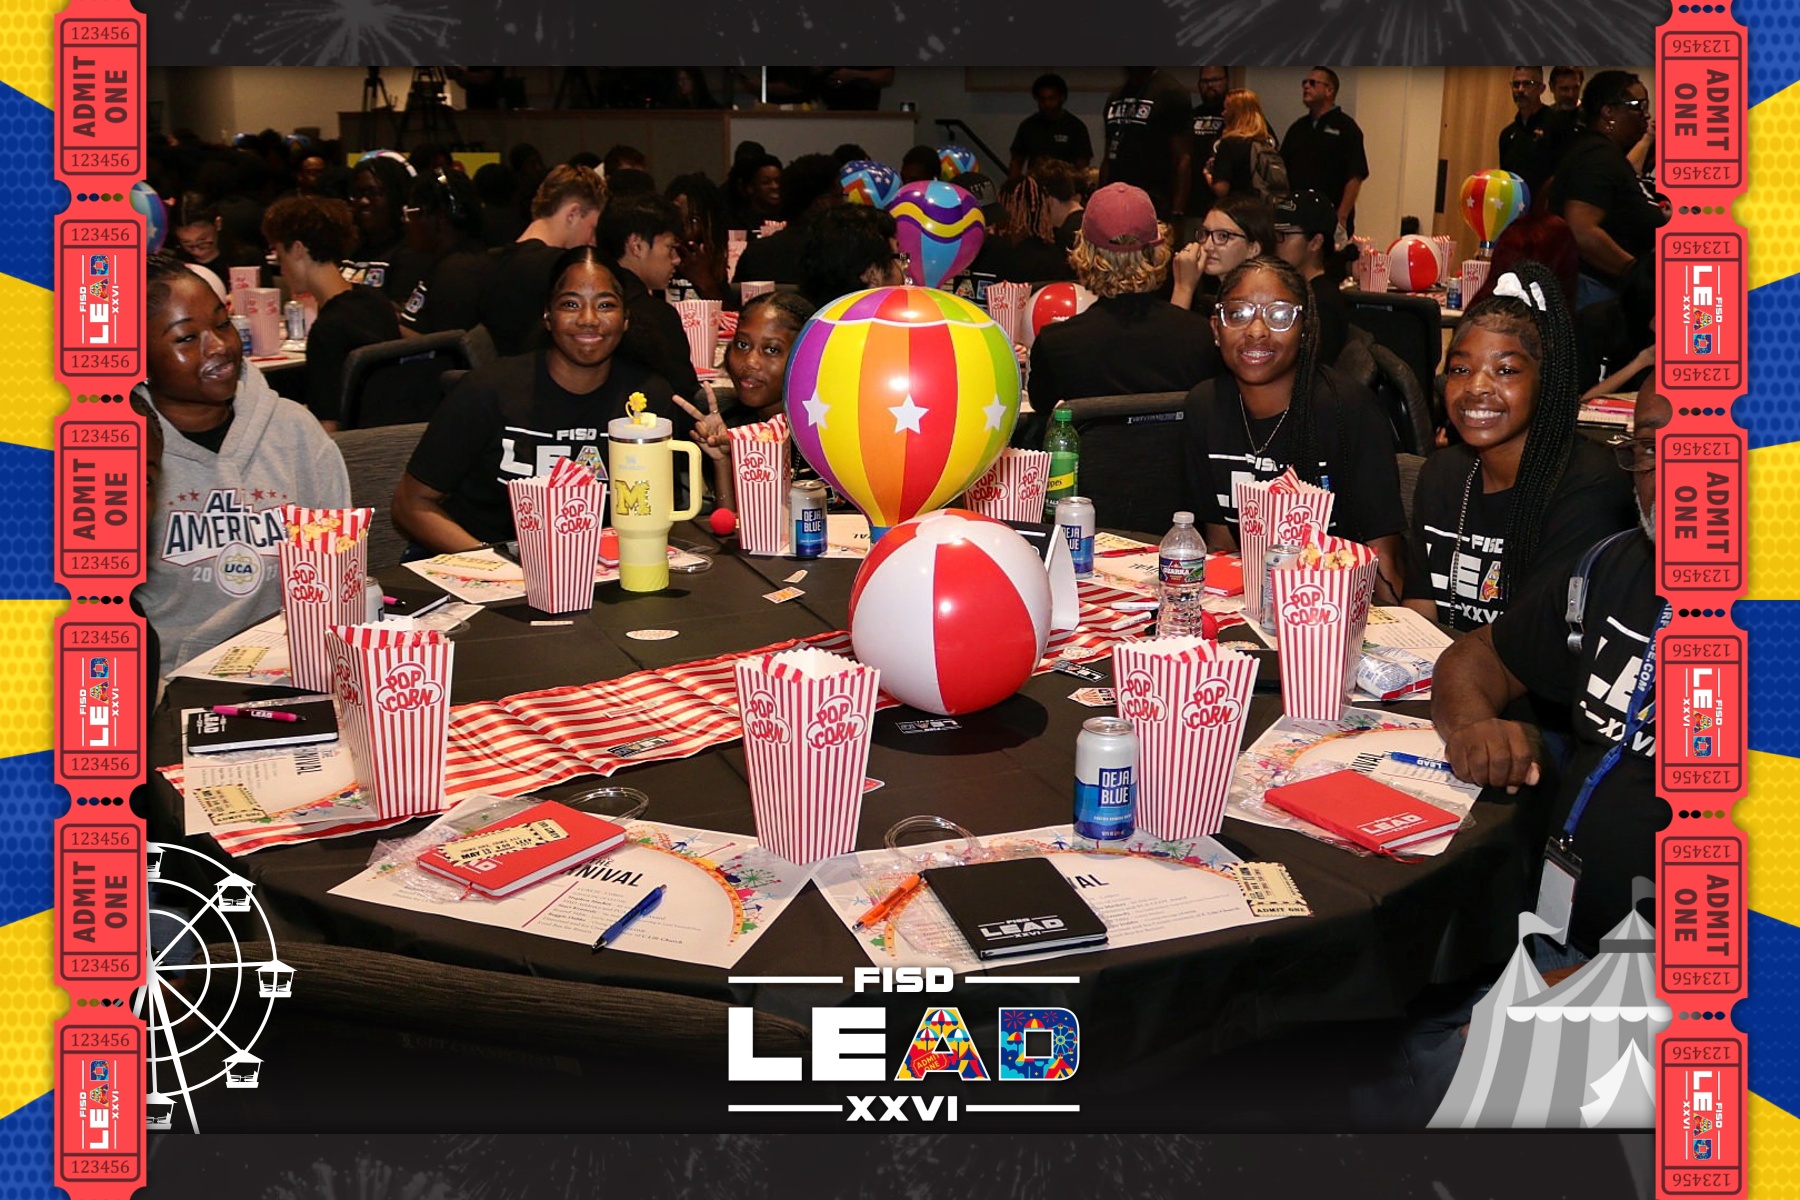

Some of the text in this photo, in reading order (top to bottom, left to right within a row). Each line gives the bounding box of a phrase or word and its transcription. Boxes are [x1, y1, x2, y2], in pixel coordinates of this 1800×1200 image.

[556, 428, 597, 440] FISD
[500, 438, 609, 480] LEA
[743, 457, 763, 469] POP
[742, 470, 770, 481] CORN
[1022, 472, 1037, 486] POP
[614, 480, 651, 516] M
[973, 488, 1002, 502] CORN
[519, 502, 533, 515] POP
[561, 504, 584, 519] POP
[804, 510, 821, 521] DEJA
[1244, 506, 1259, 519] POP
[520, 516, 541, 531] CORN
[560, 518, 591, 534] CORN
[804, 521, 821, 532] BLUE
[1285, 511, 1310, 527] POP
[166, 510, 285, 555] AMERICA
[1244, 521, 1263, 536] CORN
[224, 564, 253, 574] UCA
[293, 569, 315, 586] POP
[293, 585, 324, 603] CORN
[1290, 591, 1321, 609] POP
[1290, 608, 1331, 626] CORN
[385, 670, 422, 693] POP
[1126, 678, 1151, 697] POP
[385, 688, 433, 713] CORN
[1193, 686, 1226, 709] POP
[750, 699, 774, 719] POP
[816, 703, 849, 728] POP
[1126, 698, 1160, 722] CORN
[1189, 706, 1233, 729] CORN
[751, 720, 783, 743] CORN
[813, 721, 858, 749] CORN
[1417, 758, 1442, 769] LEAD
[1102, 771, 1130, 788] DEJA
[1101, 787, 1129, 804] BLUE
[1361, 814, 1423, 834] LEAD
[461, 850, 480, 860] MAY
[589, 858, 614, 867] THE
[562, 864, 644, 887] NIVAL
[980, 918, 1064, 937] LEAD
